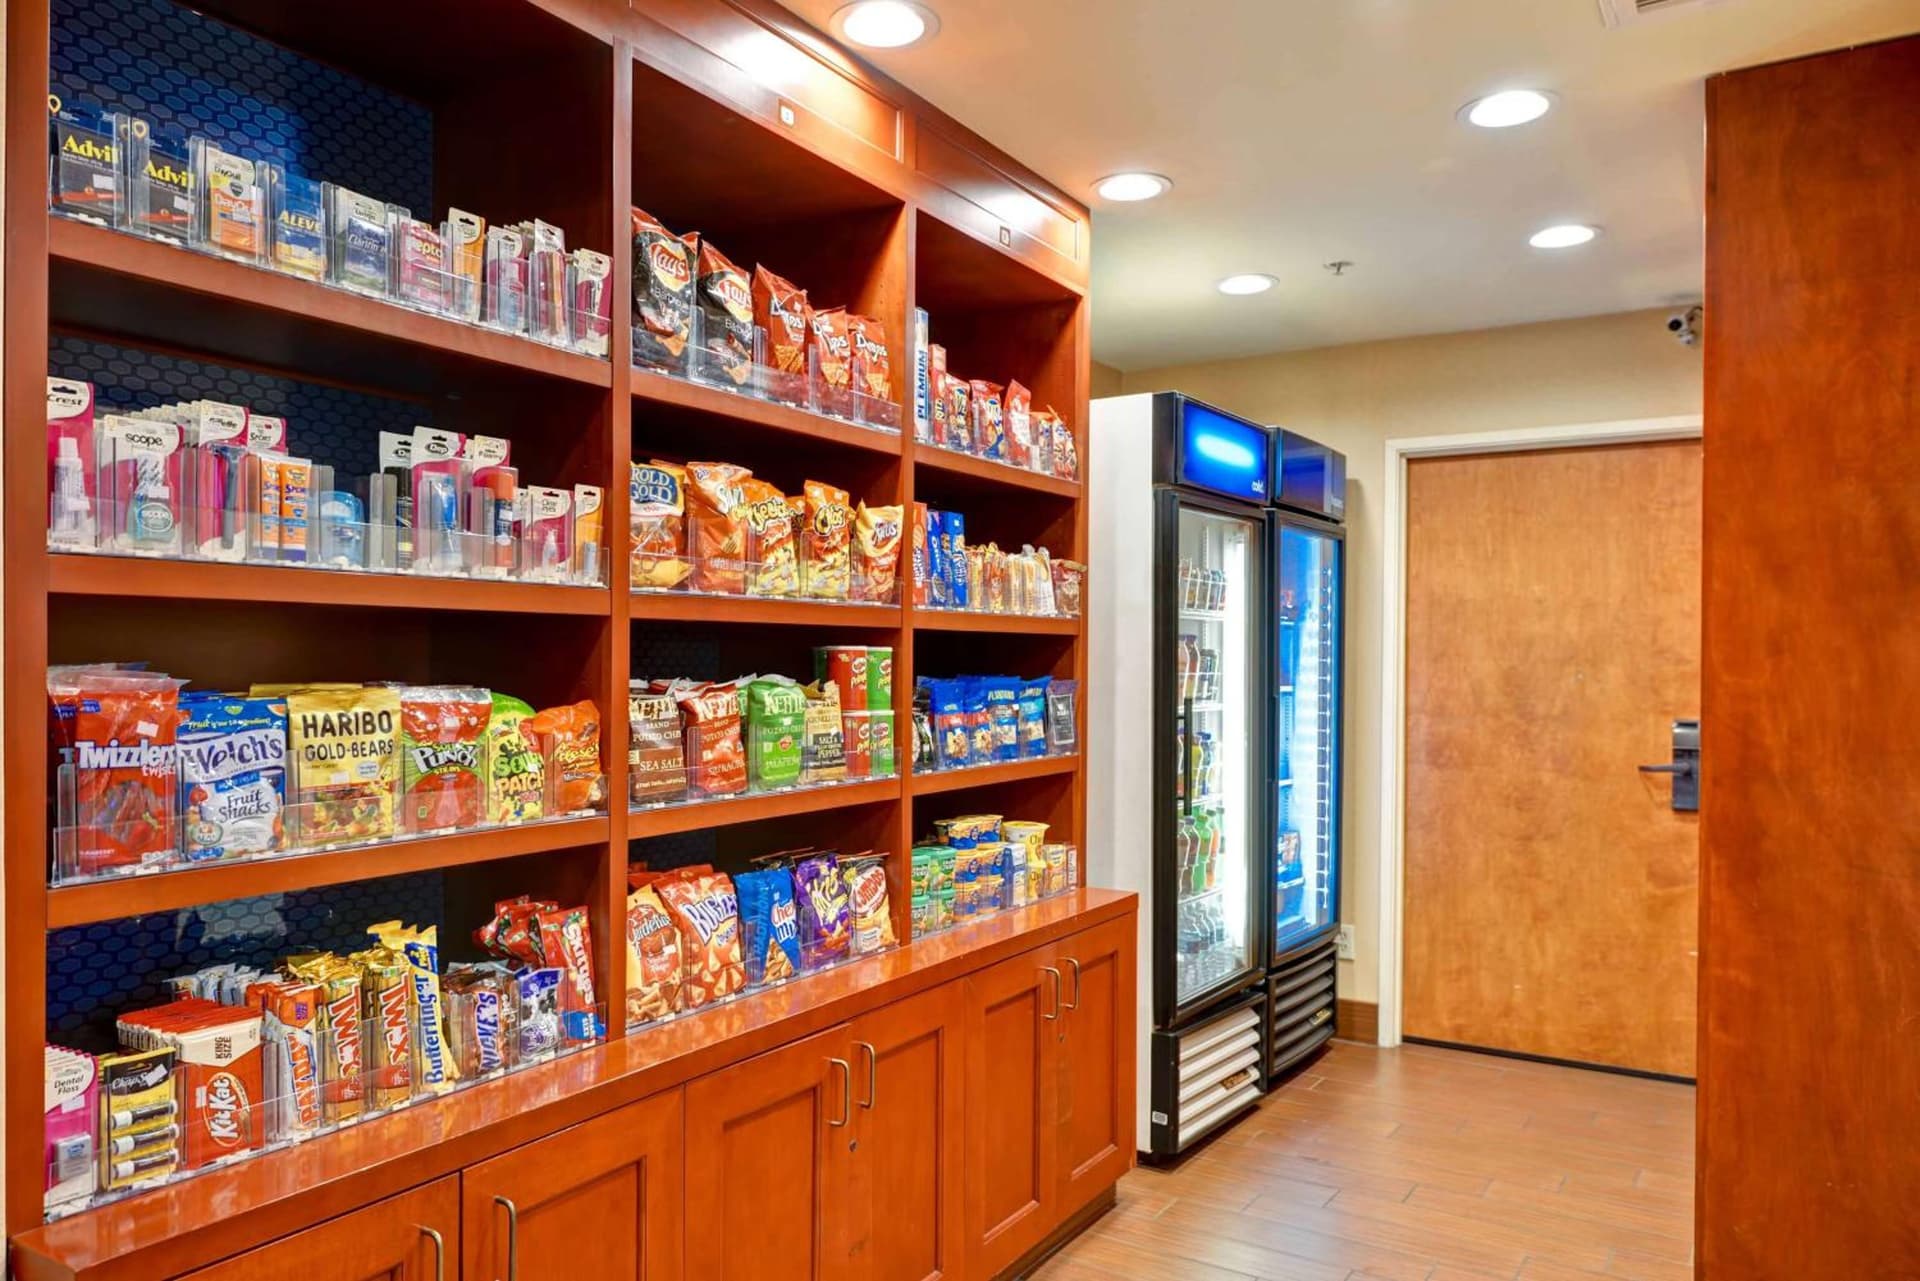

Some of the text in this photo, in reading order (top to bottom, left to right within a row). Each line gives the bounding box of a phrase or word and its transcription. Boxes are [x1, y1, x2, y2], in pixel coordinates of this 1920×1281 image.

[61, 134, 121, 165] Advil
[143, 159, 197, 190] Advil
[125, 432, 164, 447] scope
[629, 482, 673, 503] GOLD
[301, 709, 394, 739] HARIBO
[75, 738, 177, 769] Twizzlers
[181, 733, 284, 775] Welch's
[640, 757, 683, 772] SEA SALT
[226, 788, 264, 809] Fruit
[218, 802, 273, 825] Snacks
[214, 1036, 225, 1059] KING
[223, 1036, 232, 1059] SIZE
[54, 1074, 84, 1089] Dental
[57, 1084, 80, 1096] Floss
